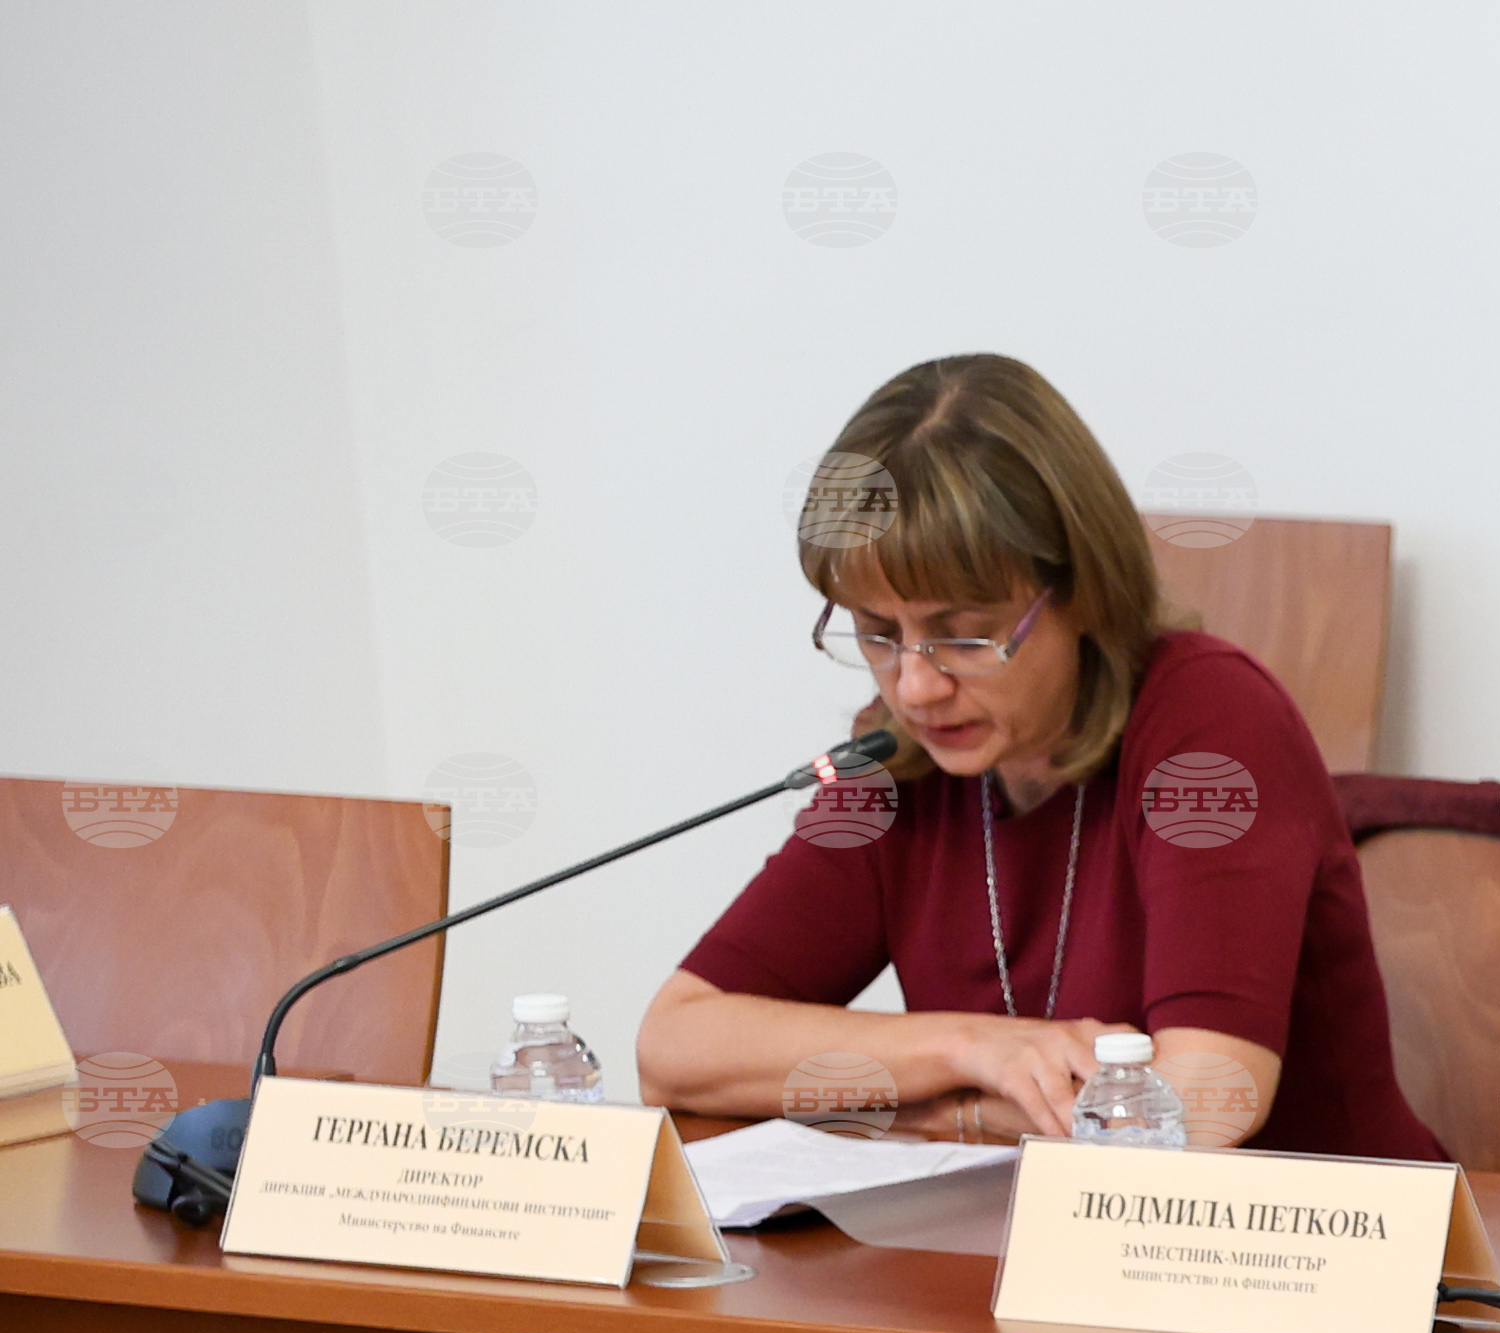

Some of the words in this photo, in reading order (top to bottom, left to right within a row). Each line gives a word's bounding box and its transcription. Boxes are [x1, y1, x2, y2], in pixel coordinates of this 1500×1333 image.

[313, 1115, 427, 1150] ГЕРГАНА
[438, 1125, 589, 1163] БЕРЕМСКА
[398, 1167, 483, 1188] ДИРЕКТОР
[339, 1212, 430, 1234] Министерство
[432, 1222, 447, 1234] на
[450, 1221, 520, 1240] Финансите
[1073, 1191, 1236, 1229] ЛЮДМИЛА
[1246, 1203, 1387, 1240] ПЕТКОВА
[1121, 1243, 1327, 1272] ЗАМЕСТНИК-МИНИСТЪР
[1121, 1268, 1218, 1286] МИНИСТЕРСТВО
[1222, 1277, 1238, 1288] НА
[1241, 1277, 1318, 1294] ФИНАНСИТЕ
